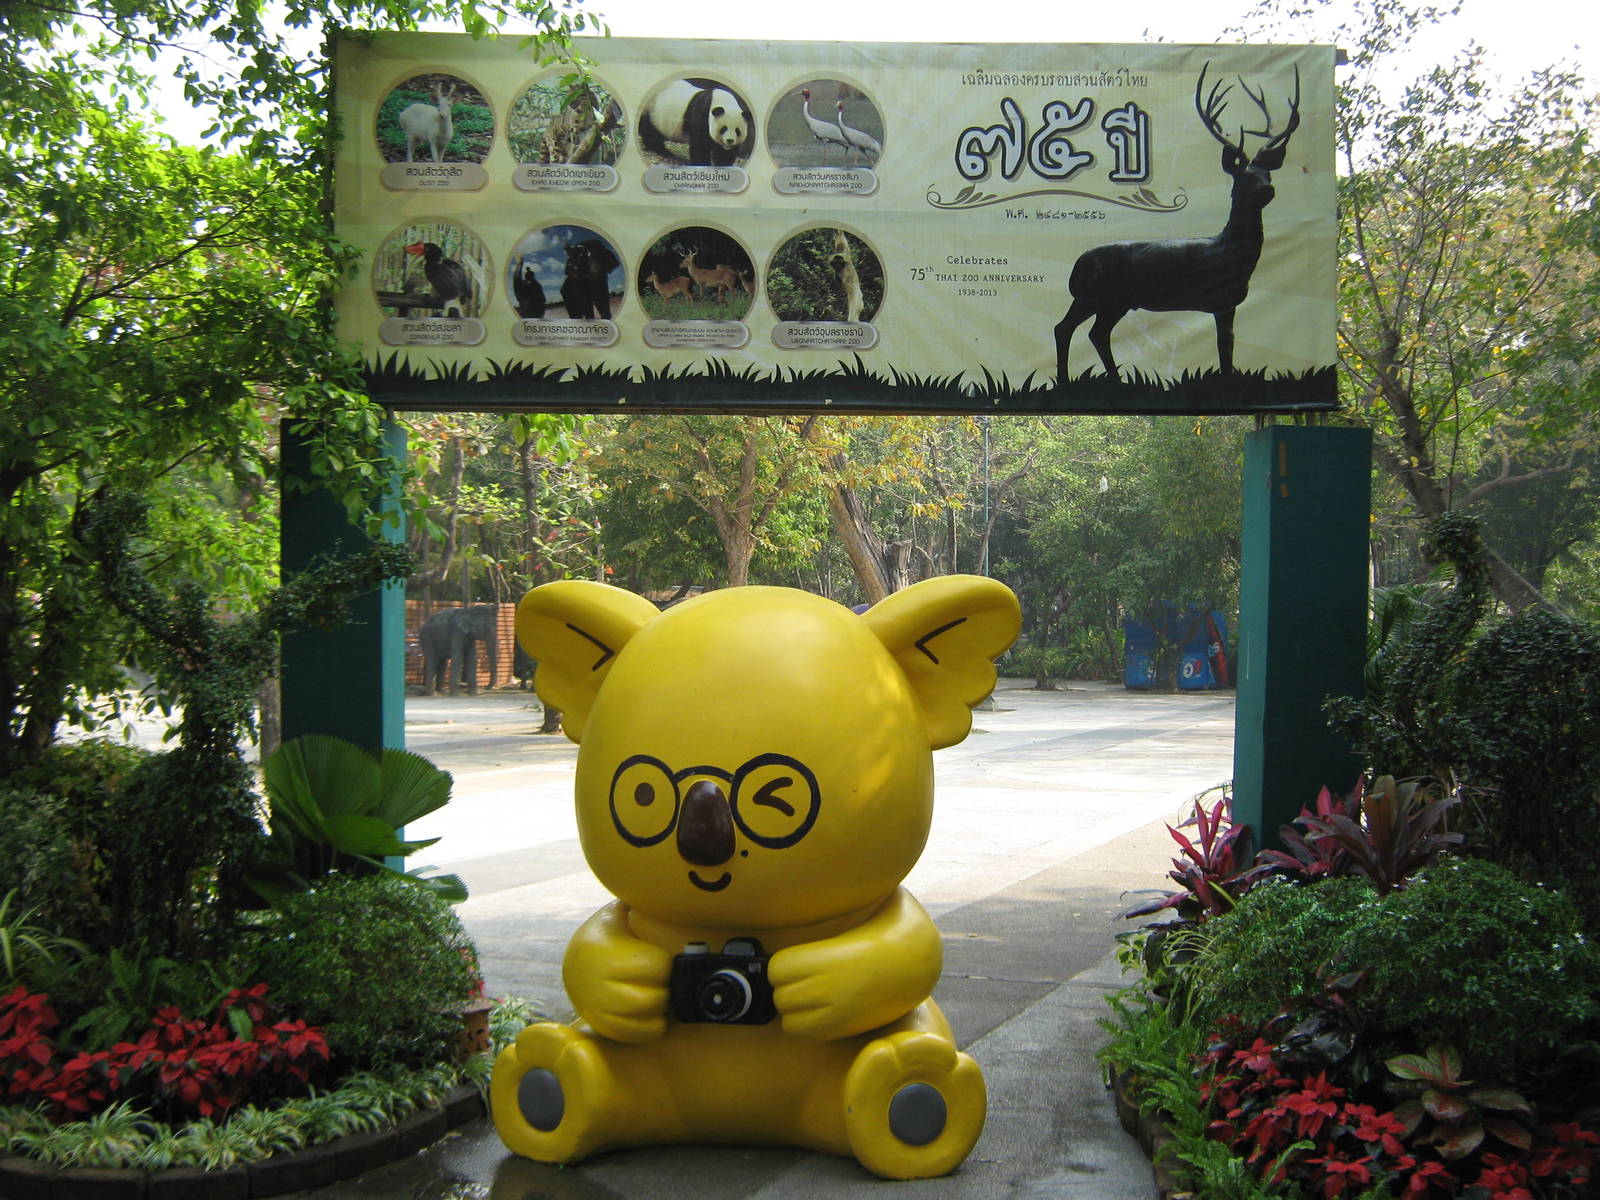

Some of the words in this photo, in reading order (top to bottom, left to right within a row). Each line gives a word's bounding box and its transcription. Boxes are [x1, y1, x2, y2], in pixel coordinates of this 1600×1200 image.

[946, 255, 1009, 266] Celebrates
[935, 274, 958, 282] THAI
[962, 274, 979, 282] ZOO
[983, 275, 1045, 283] ANNIVERSARY
[958, 289, 998, 297] 1938-2013
